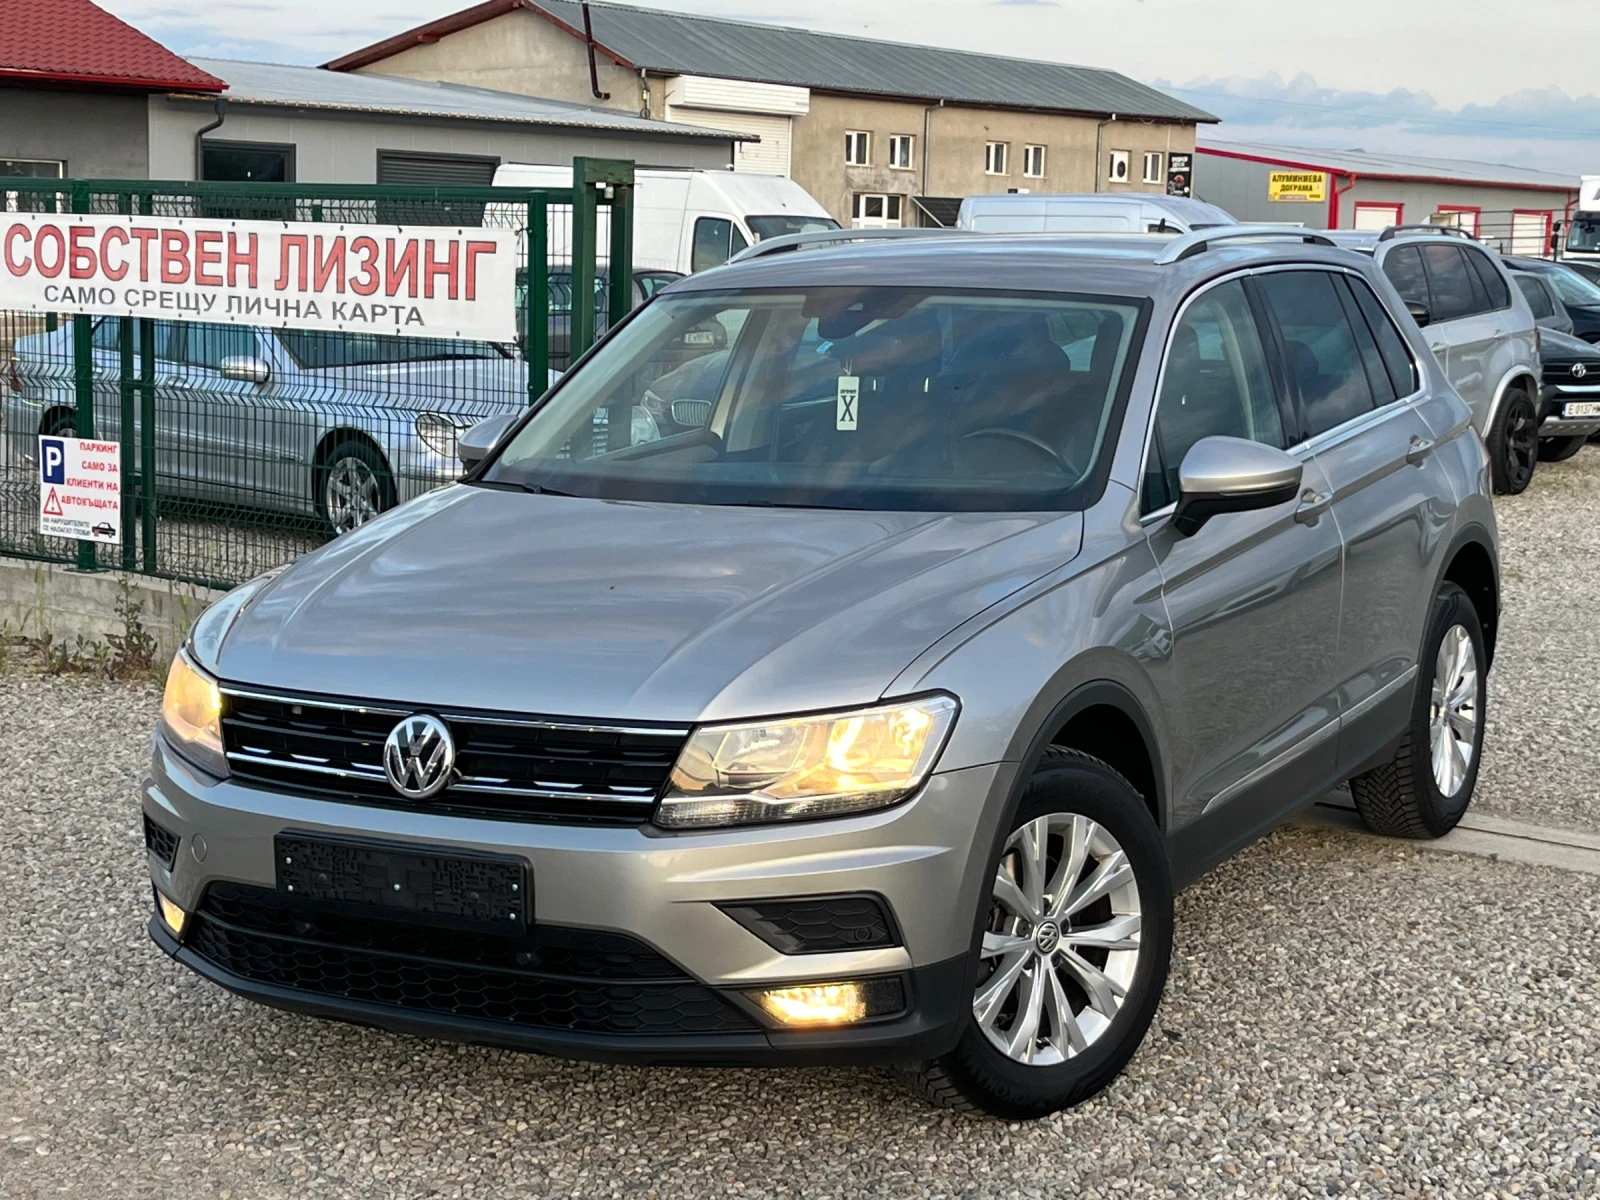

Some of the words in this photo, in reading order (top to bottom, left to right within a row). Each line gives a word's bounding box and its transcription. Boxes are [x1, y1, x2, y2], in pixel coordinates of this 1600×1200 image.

[1272, 174, 1322, 182] АЛУМИНИЕВА
[1280, 184, 1313, 192] ДОГРАМА
[4, 224, 258, 287] СОБСТВЕН
[275, 234, 497, 299] ЛИЗИНГ
[44, 285, 116, 305] САМО
[124, 288, 217, 315] СРЕЩУ
[225, 295, 322, 320] ЛИЧНА
[331, 302, 425, 327] КАРТА
[80, 442, 118, 454] ПАРКИНГ
[45, 446, 62, 477] P
[81, 460, 105, 471] САМО
[107, 463, 118, 473] ЗА
[66, 477, 104, 489] КЛИЕНТИ
[106, 481, 119, 491] НА
[61, 495, 119, 510] АВТОКЪЩАТА
